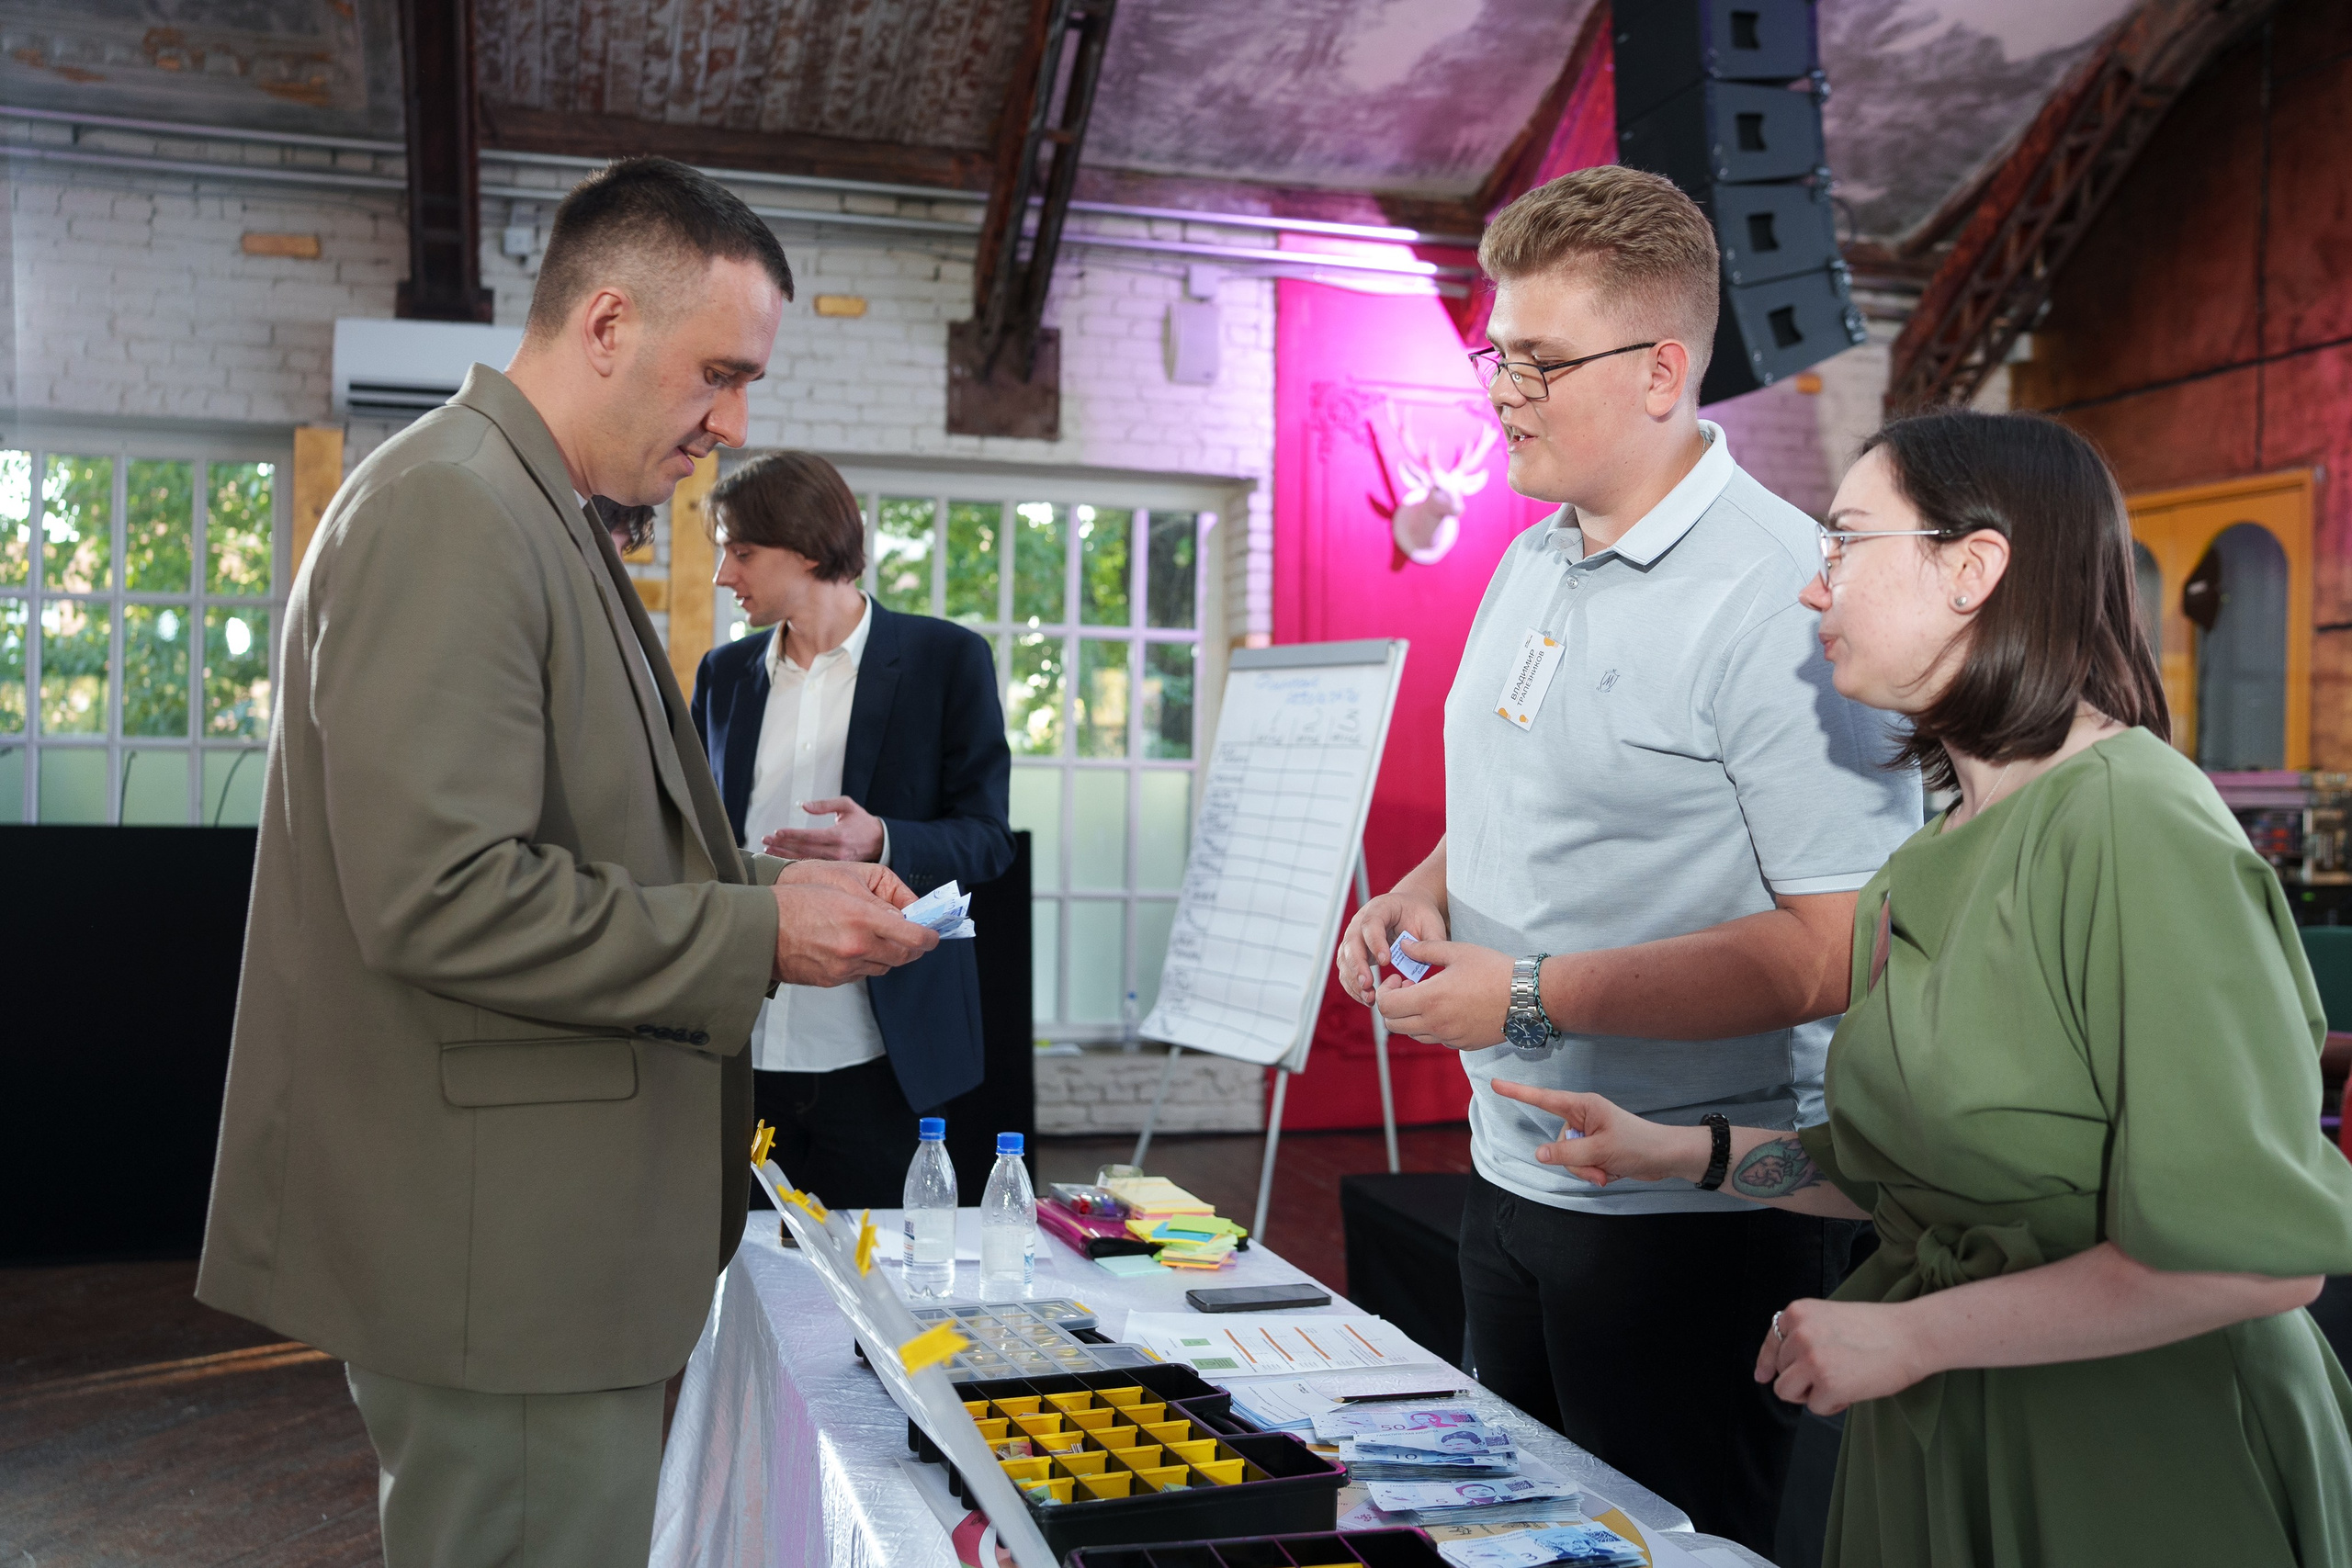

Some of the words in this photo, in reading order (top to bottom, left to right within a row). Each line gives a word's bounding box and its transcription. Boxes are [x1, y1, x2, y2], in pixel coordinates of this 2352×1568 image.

[1510, 649, 1535, 701] ВЛАДИМИР
[1517, 650, 1544, 706] ТРАПЕЗНИКОВ
[1381, 1424, 1406, 1432] 50
[1521, 1552, 1538, 1562] 3
